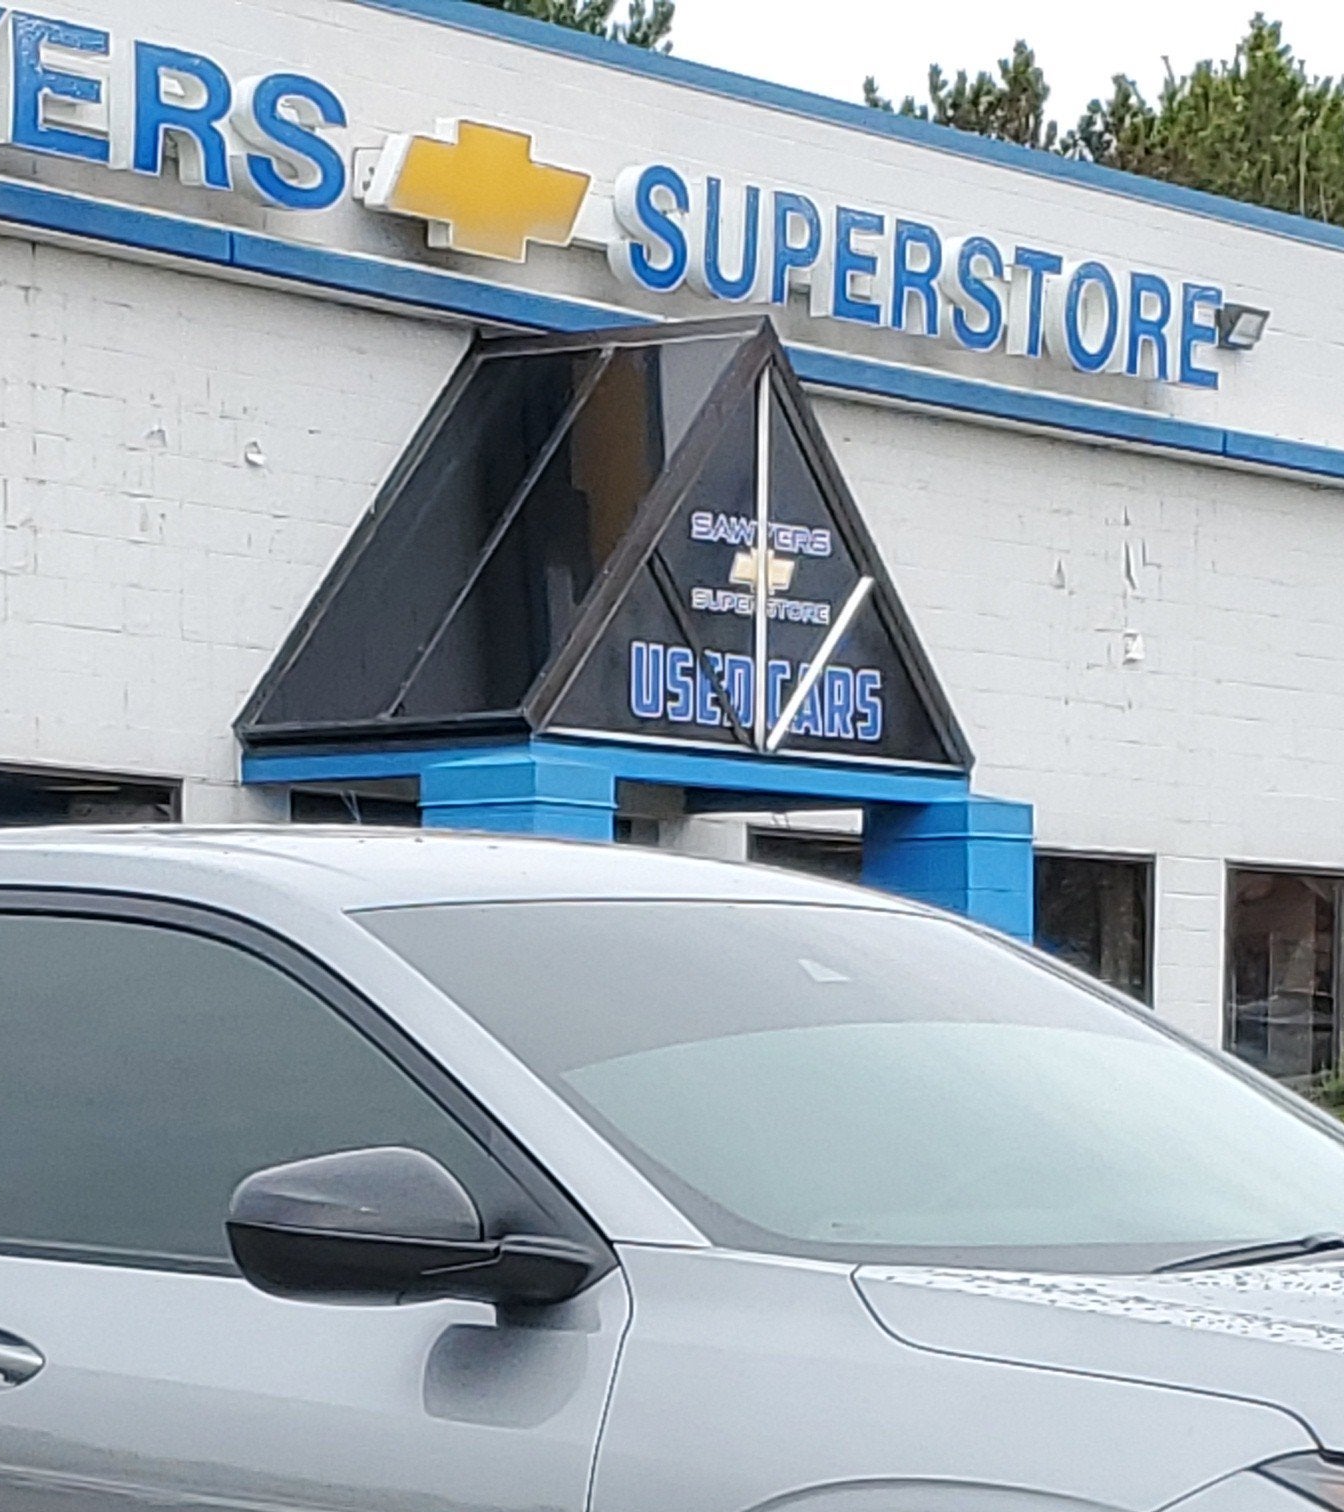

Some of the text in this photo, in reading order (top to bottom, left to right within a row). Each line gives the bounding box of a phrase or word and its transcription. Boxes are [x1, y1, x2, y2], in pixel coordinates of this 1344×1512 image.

[626, 163, 1222, 390] SUPERSTORE
[691, 586, 831, 626] SUPESTORE
[631, 640, 883, 742] USED CARS
